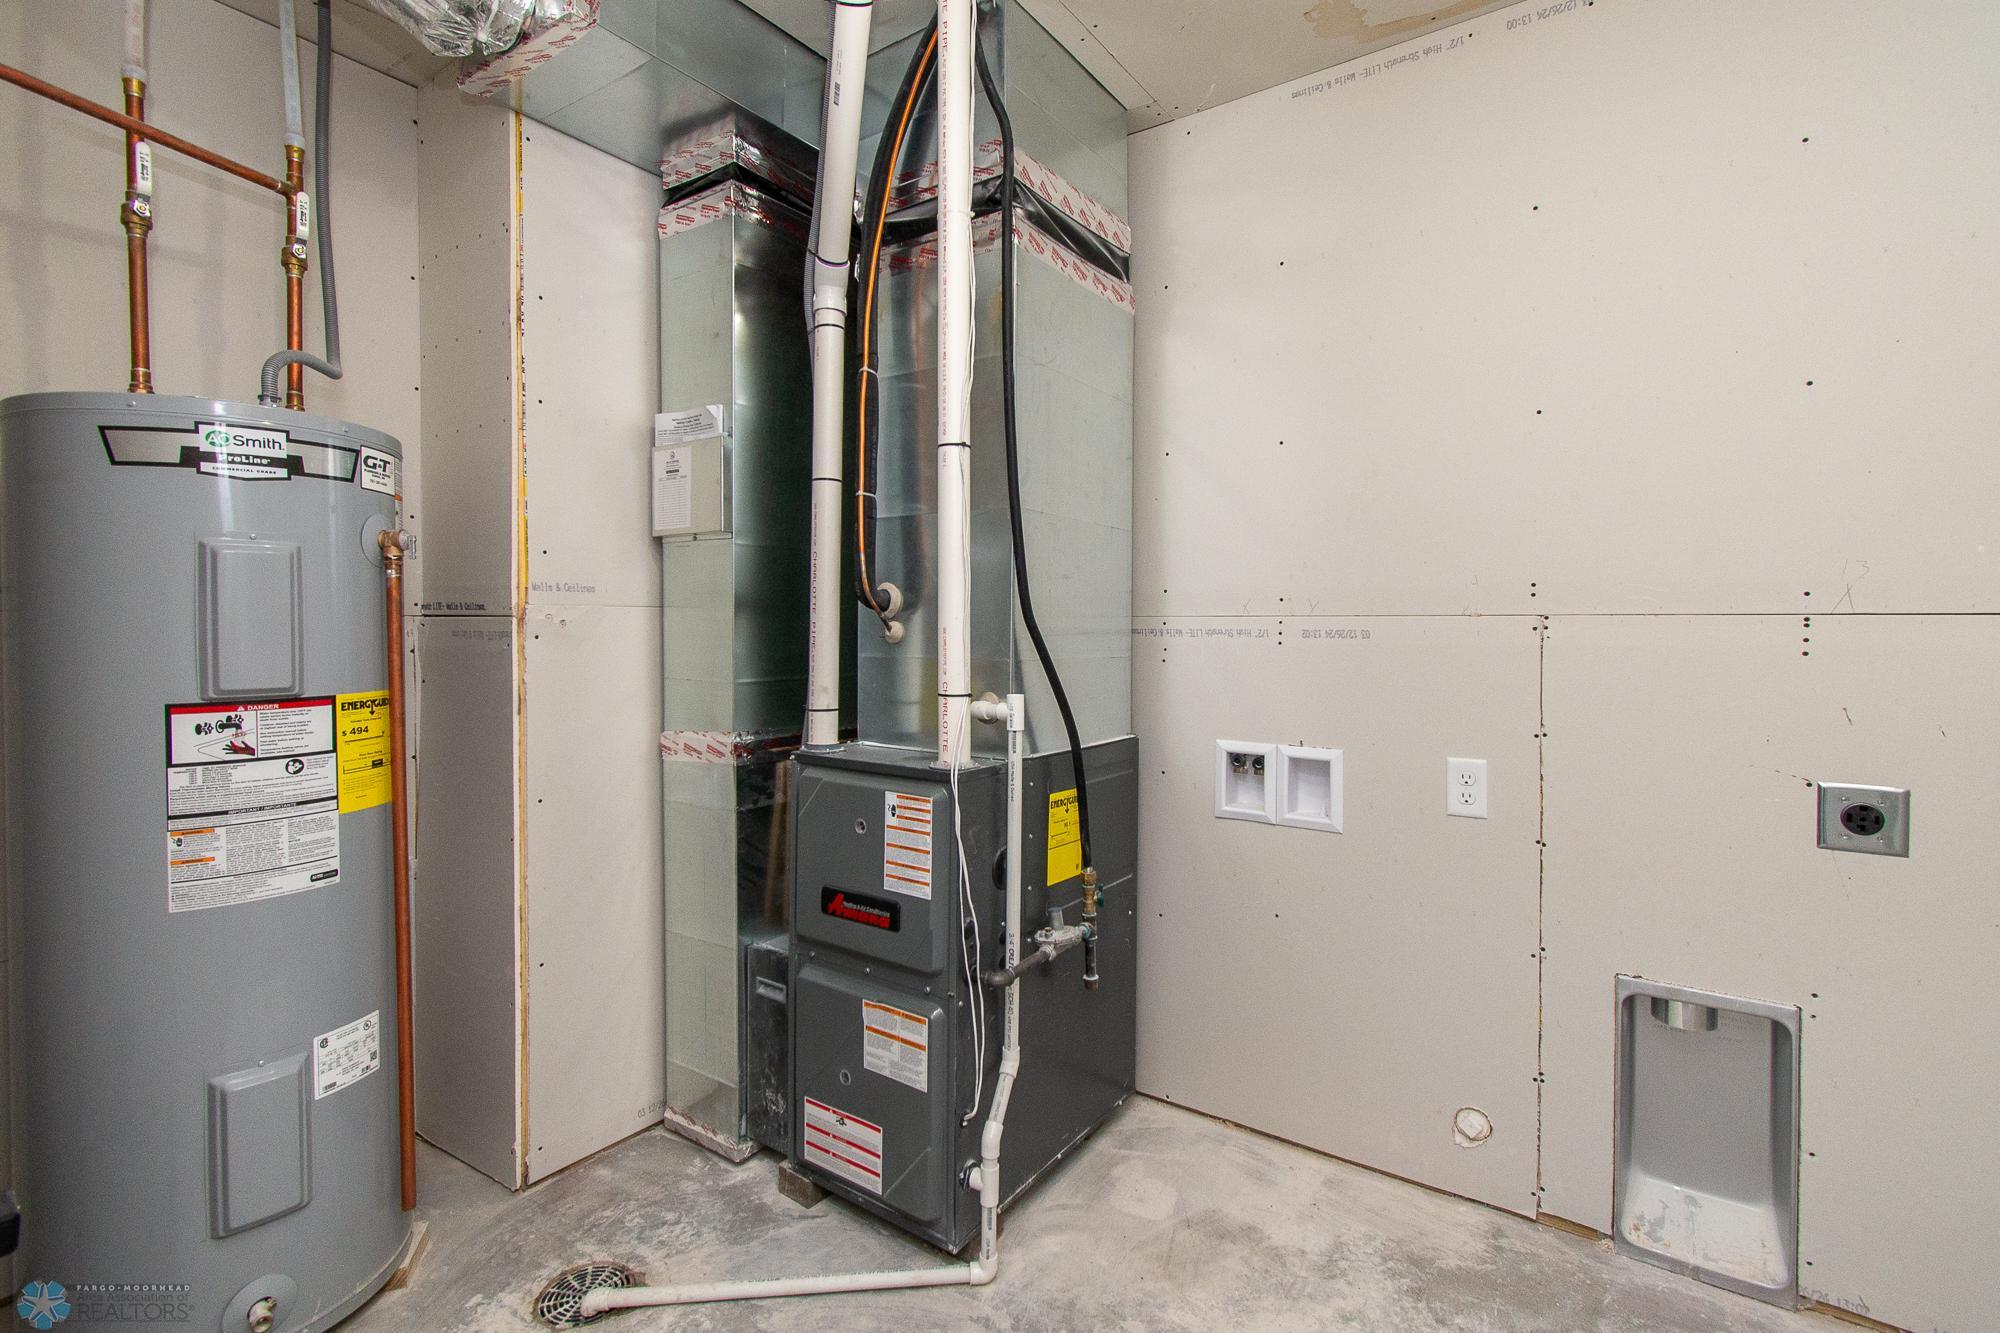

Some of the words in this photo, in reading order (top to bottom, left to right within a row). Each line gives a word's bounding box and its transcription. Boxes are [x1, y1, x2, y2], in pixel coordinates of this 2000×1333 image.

[232, 434, 284, 450] Smith
[247, 703, 280, 711] DANGER
[349, 725, 369, 736] 494
